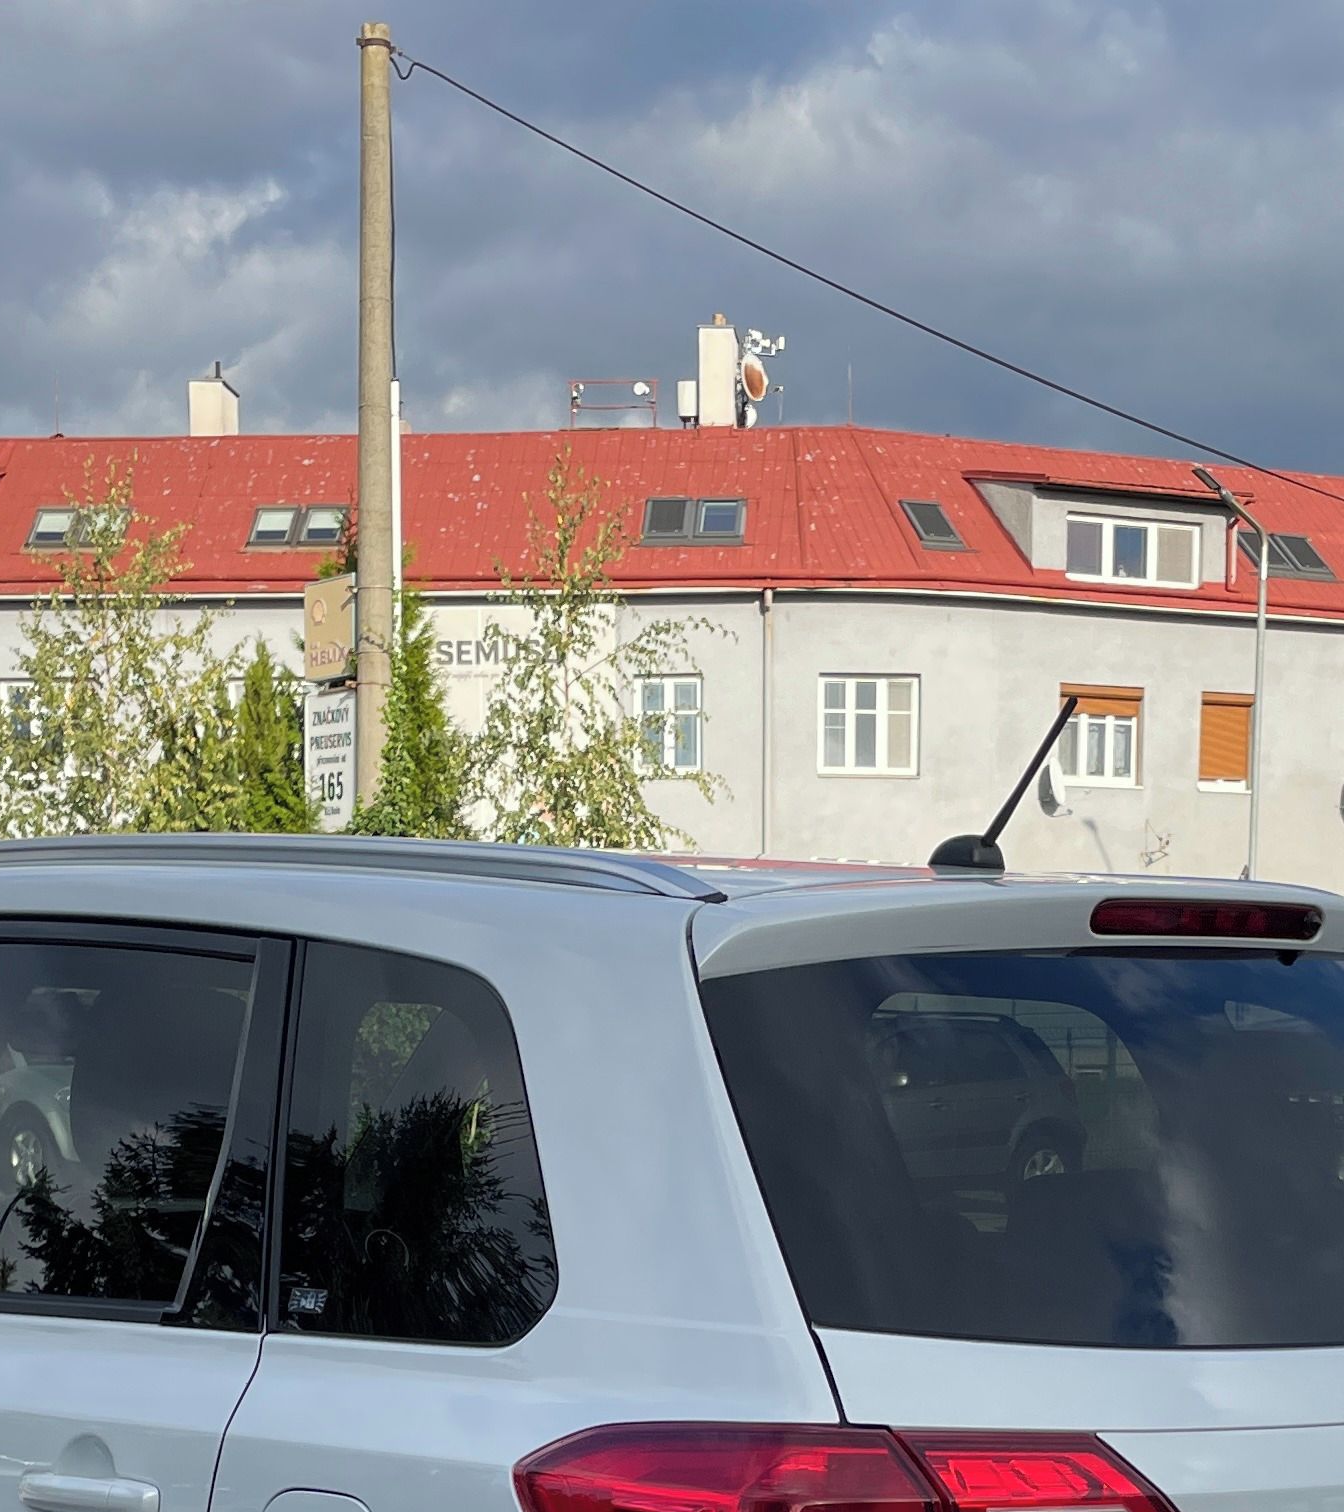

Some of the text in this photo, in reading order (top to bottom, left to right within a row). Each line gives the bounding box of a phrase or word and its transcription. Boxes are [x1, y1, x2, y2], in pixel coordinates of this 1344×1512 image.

[310, 646, 348, 667] HELIX
[312, 704, 350, 726] ZNAČKOVÝ
[310, 731, 352, 751] PNEUSERVIS
[320, 771, 344, 802] 165
